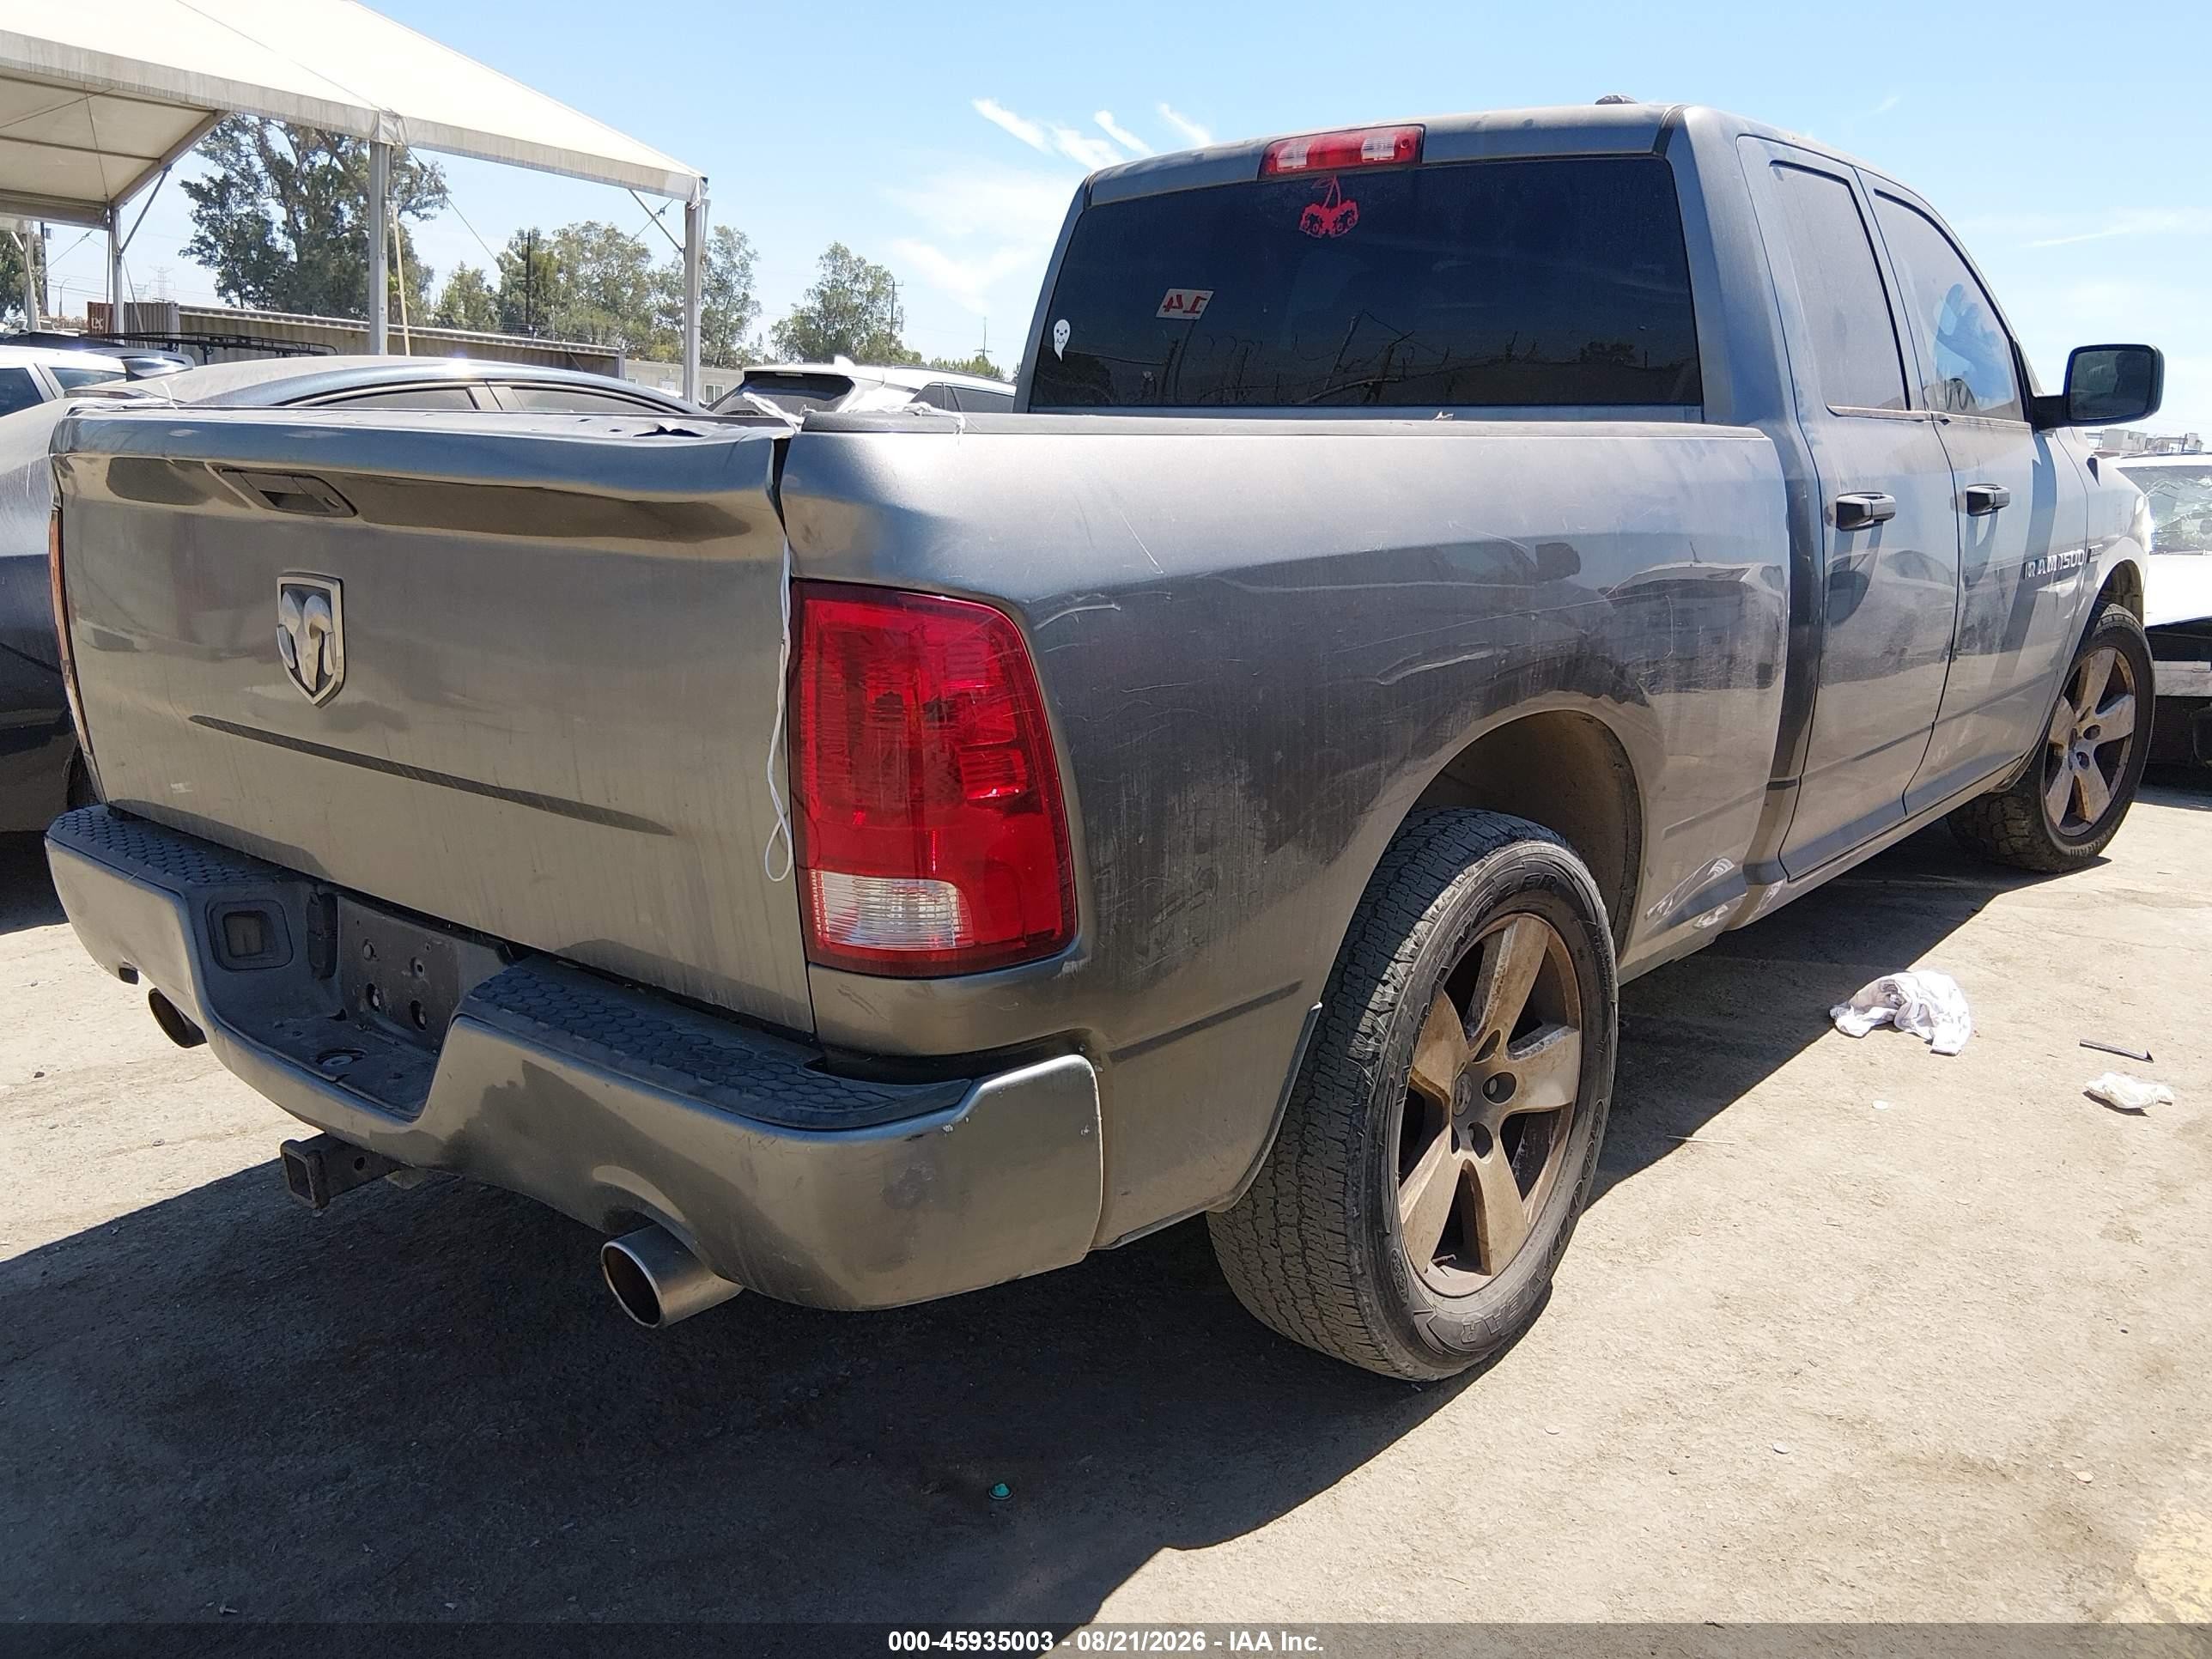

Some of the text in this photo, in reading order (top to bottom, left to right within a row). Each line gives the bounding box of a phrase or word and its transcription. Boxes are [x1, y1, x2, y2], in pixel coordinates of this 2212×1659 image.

[2024, 549, 2085, 579] RAM 1500
[1461, 1098, 1605, 1345] GOODYEAR
